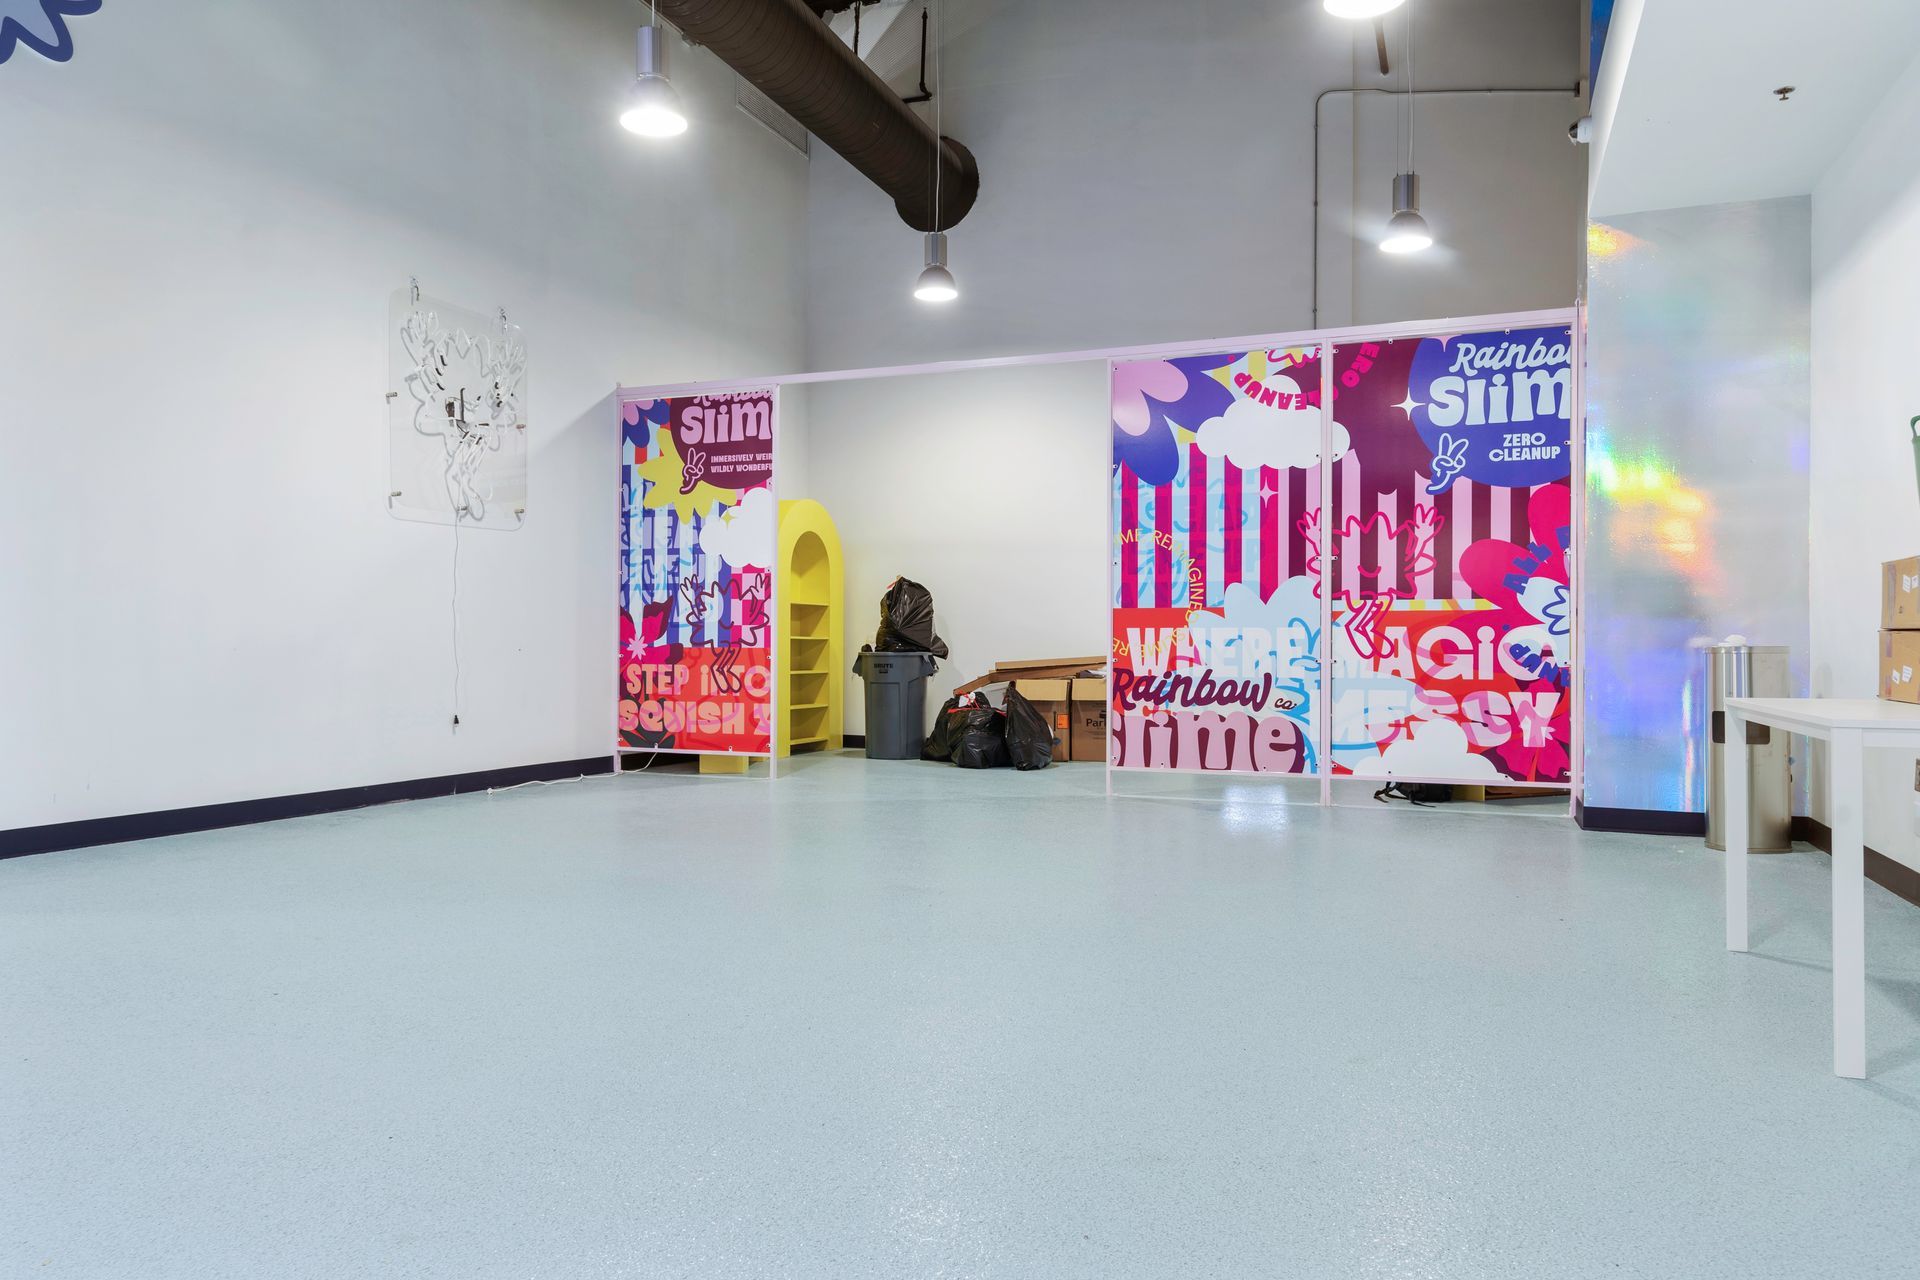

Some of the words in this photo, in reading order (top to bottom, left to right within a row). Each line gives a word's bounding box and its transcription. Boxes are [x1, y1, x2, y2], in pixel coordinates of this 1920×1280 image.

[1341, 342, 1380, 388] ERO
[680, 401, 772, 444] Slim
[1503, 432, 1546, 447] ZERO
[711, 454, 754, 463] IMMERSIVELY
[711, 465, 734, 473] WILDLY
[1488, 446, 1561, 462] CLEANUP
[1127, 628, 1306, 678] WHERE
[626, 664, 689, 695] STEP
[1113, 668, 1272, 712] Rainbow
[620, 699, 745, 734] SQUISH
[1310, 690, 1561, 748] MESSY
